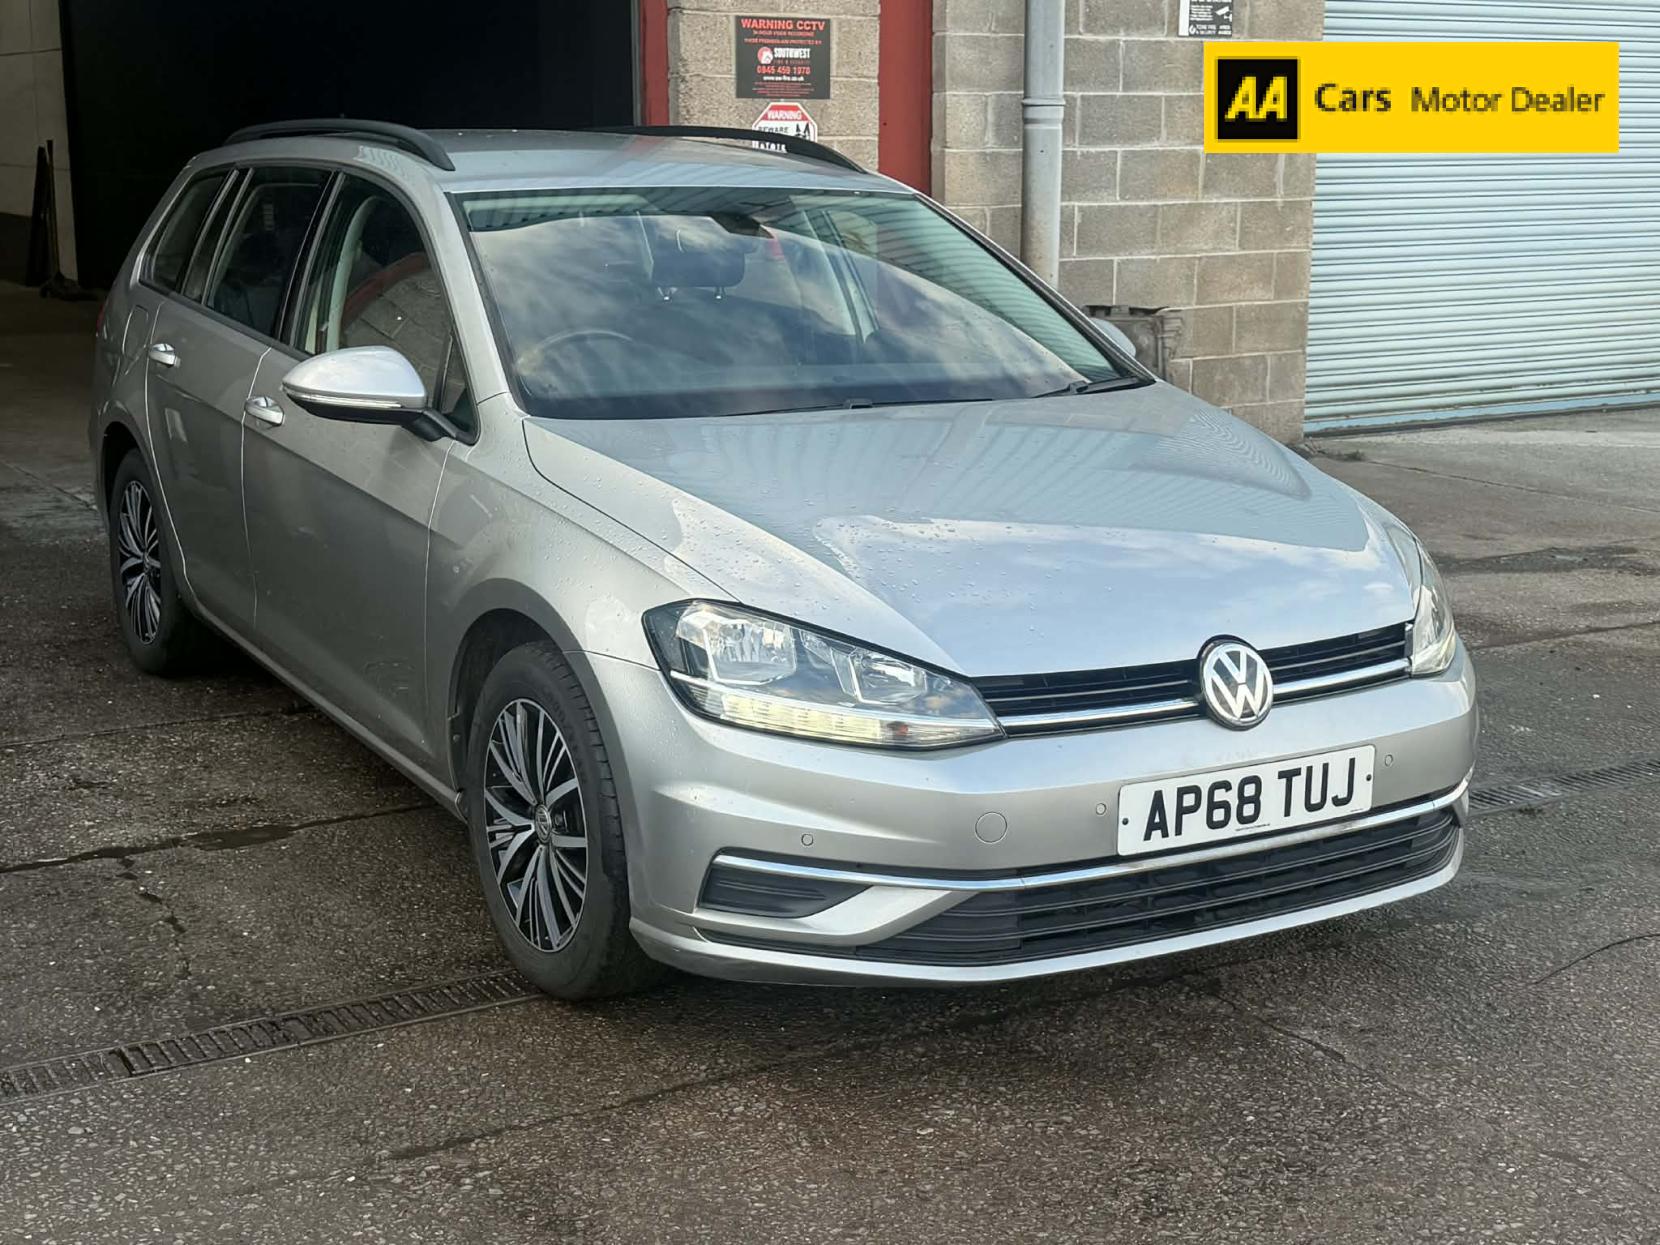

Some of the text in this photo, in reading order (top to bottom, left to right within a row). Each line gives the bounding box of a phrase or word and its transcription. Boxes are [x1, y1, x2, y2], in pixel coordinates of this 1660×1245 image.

[741, 19, 825, 30] WARNING CCTV
[768, 110, 802, 120] WARNING
[1143, 757, 1356, 842] AP68 TUJ
